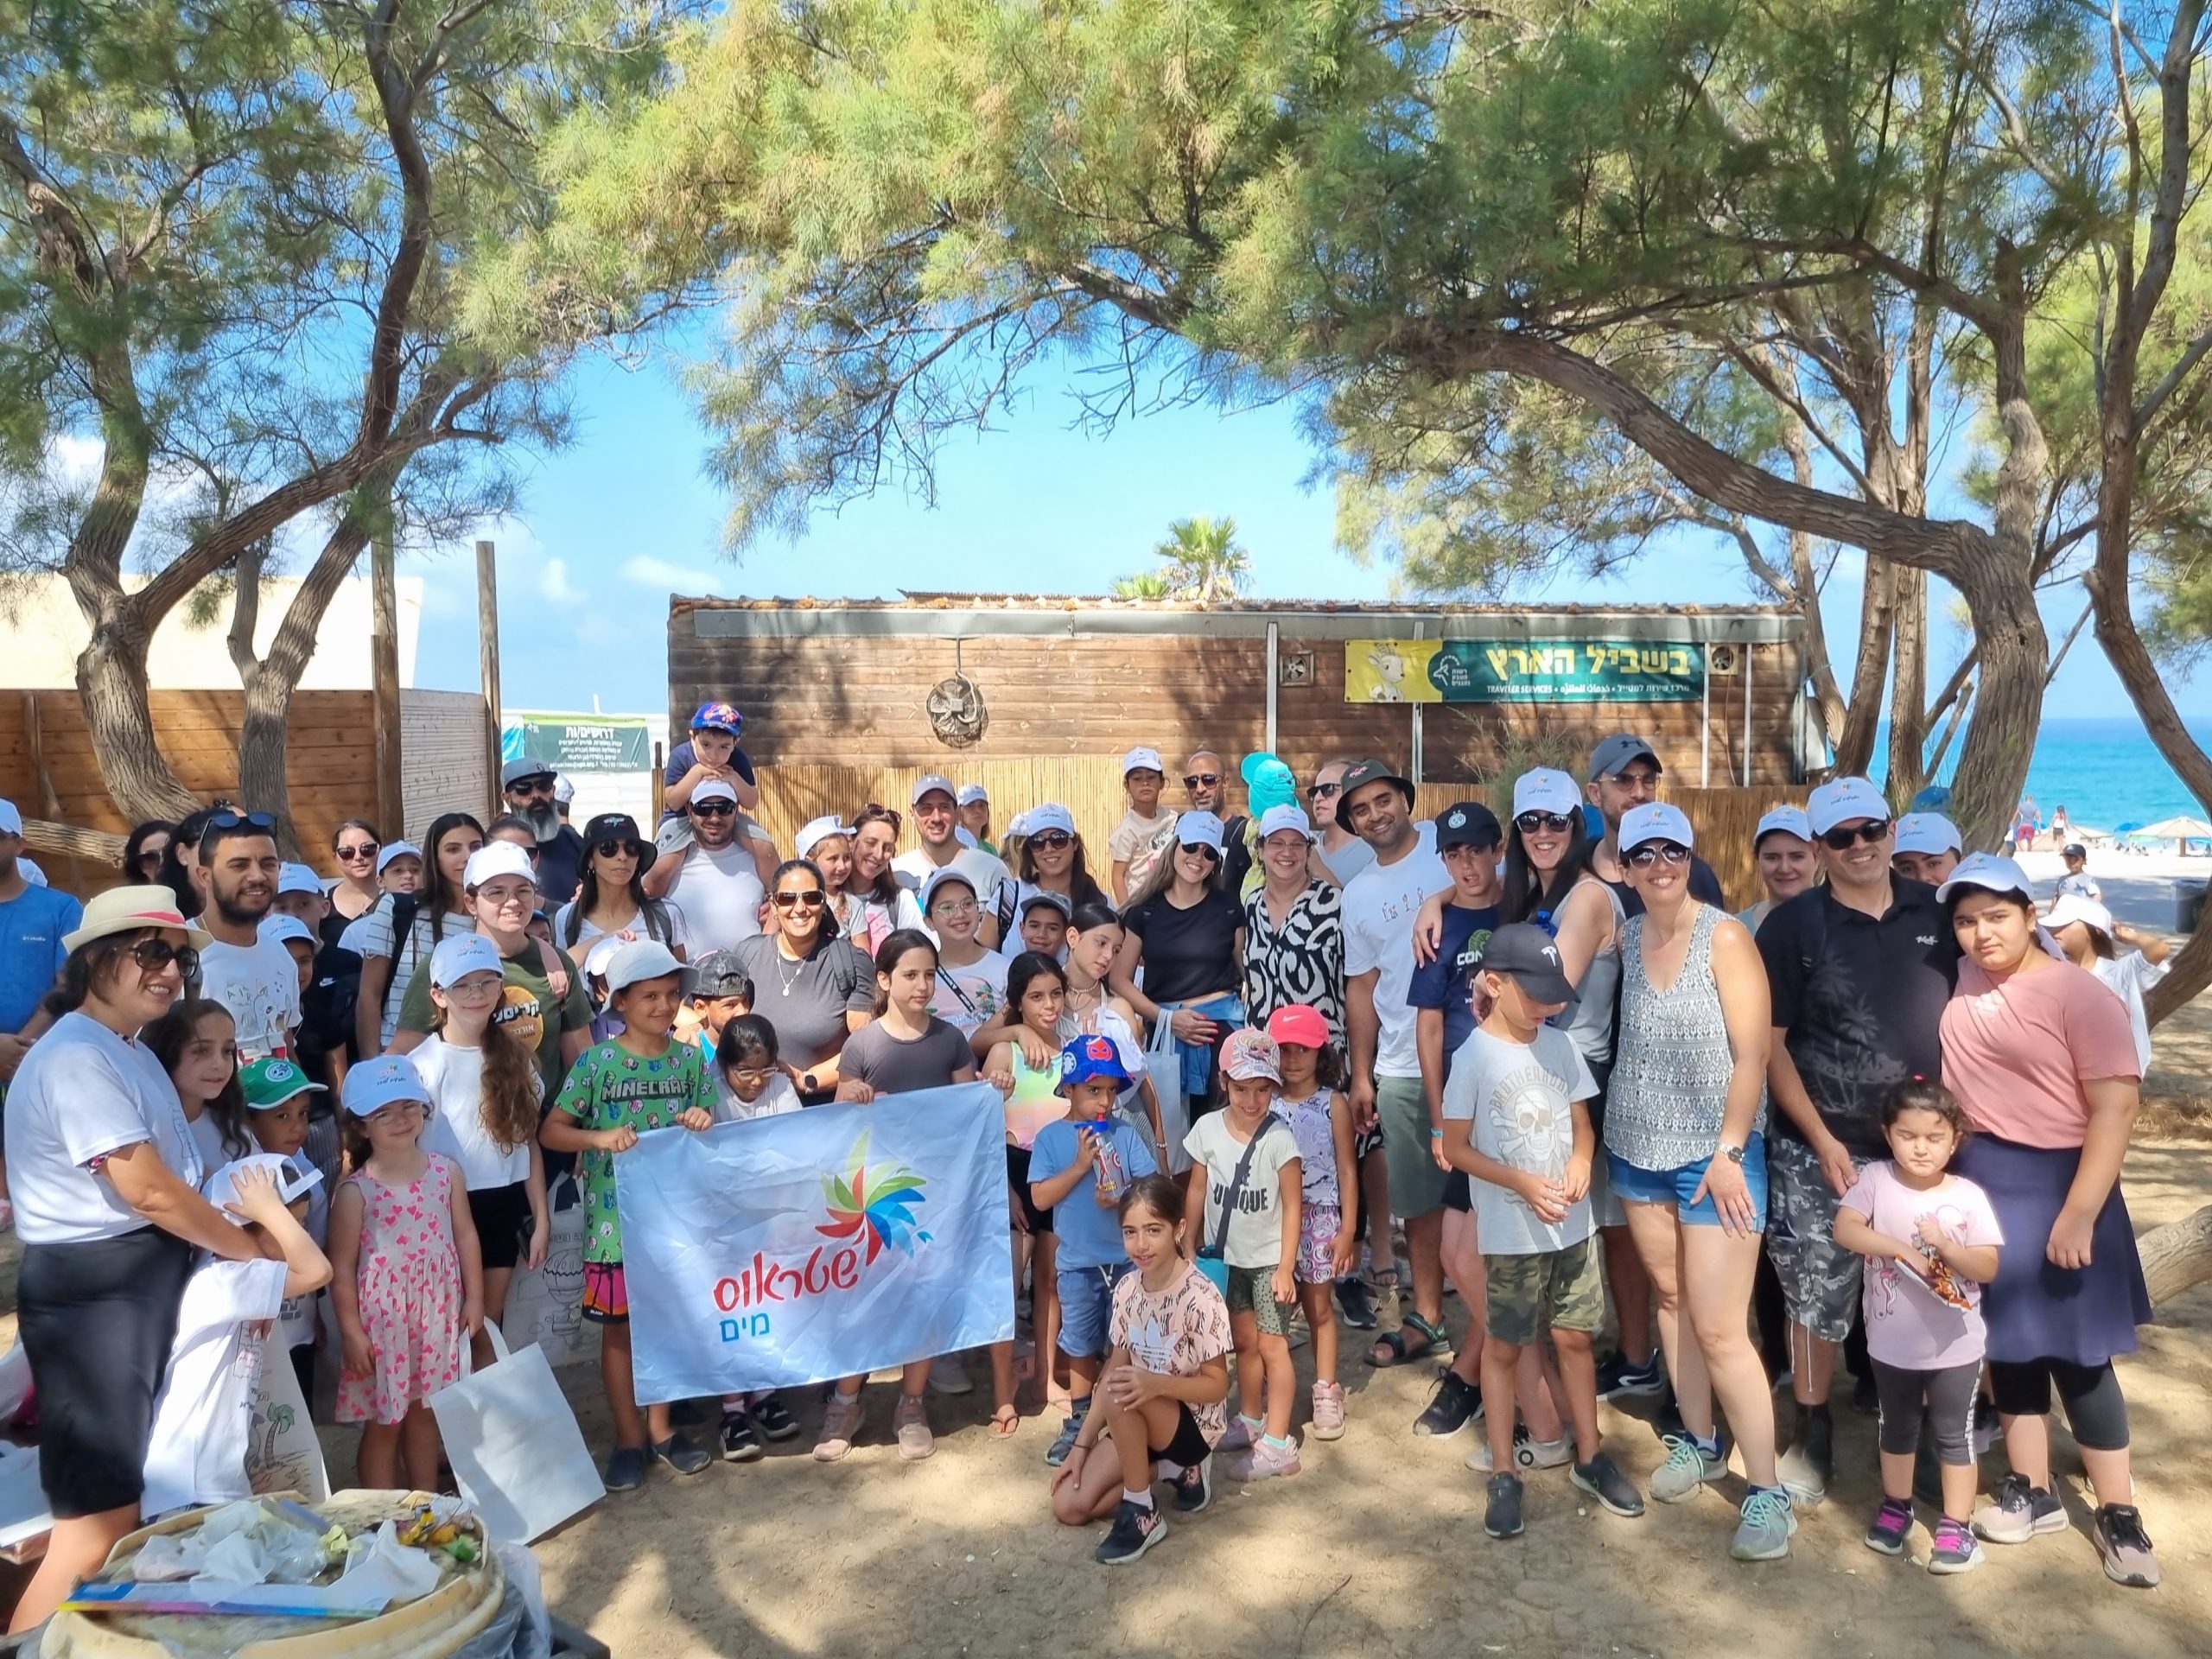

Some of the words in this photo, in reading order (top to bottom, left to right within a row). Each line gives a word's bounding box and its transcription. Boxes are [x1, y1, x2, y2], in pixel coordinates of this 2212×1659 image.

[1486, 648, 1575, 681] הארץ
[1586, 644, 1691, 676] בשביל
[1487, 685, 1520, 694] TRAVELER
[1521, 685, 1553, 694] SERVICES
[1617, 683, 1644, 693] למטייל
[1646, 684, 1669, 693] שירות
[602, 1079, 696, 1101] MINECRAFT
[713, 1245, 859, 1312] שטראוס
[719, 1313, 771, 1343] מים
